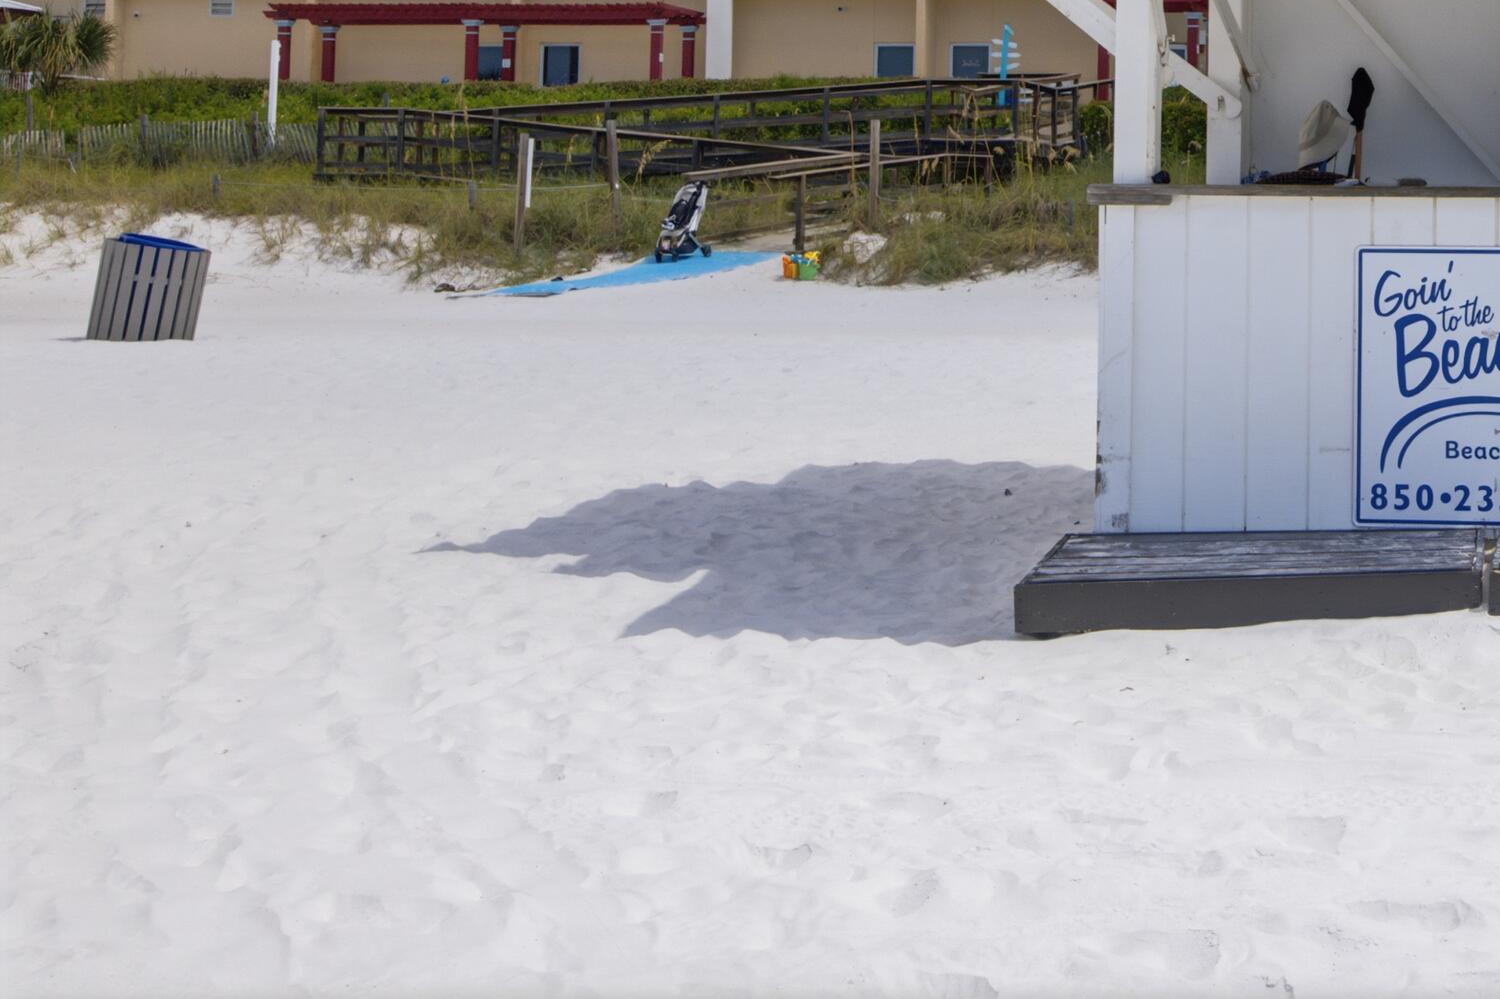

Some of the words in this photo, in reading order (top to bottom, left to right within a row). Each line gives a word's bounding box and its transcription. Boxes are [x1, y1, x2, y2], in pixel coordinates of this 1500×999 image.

[1374, 260, 1454, 317] Goin'
[1436, 306, 1461, 332] to
[1460, 296, 1494, 327] the
